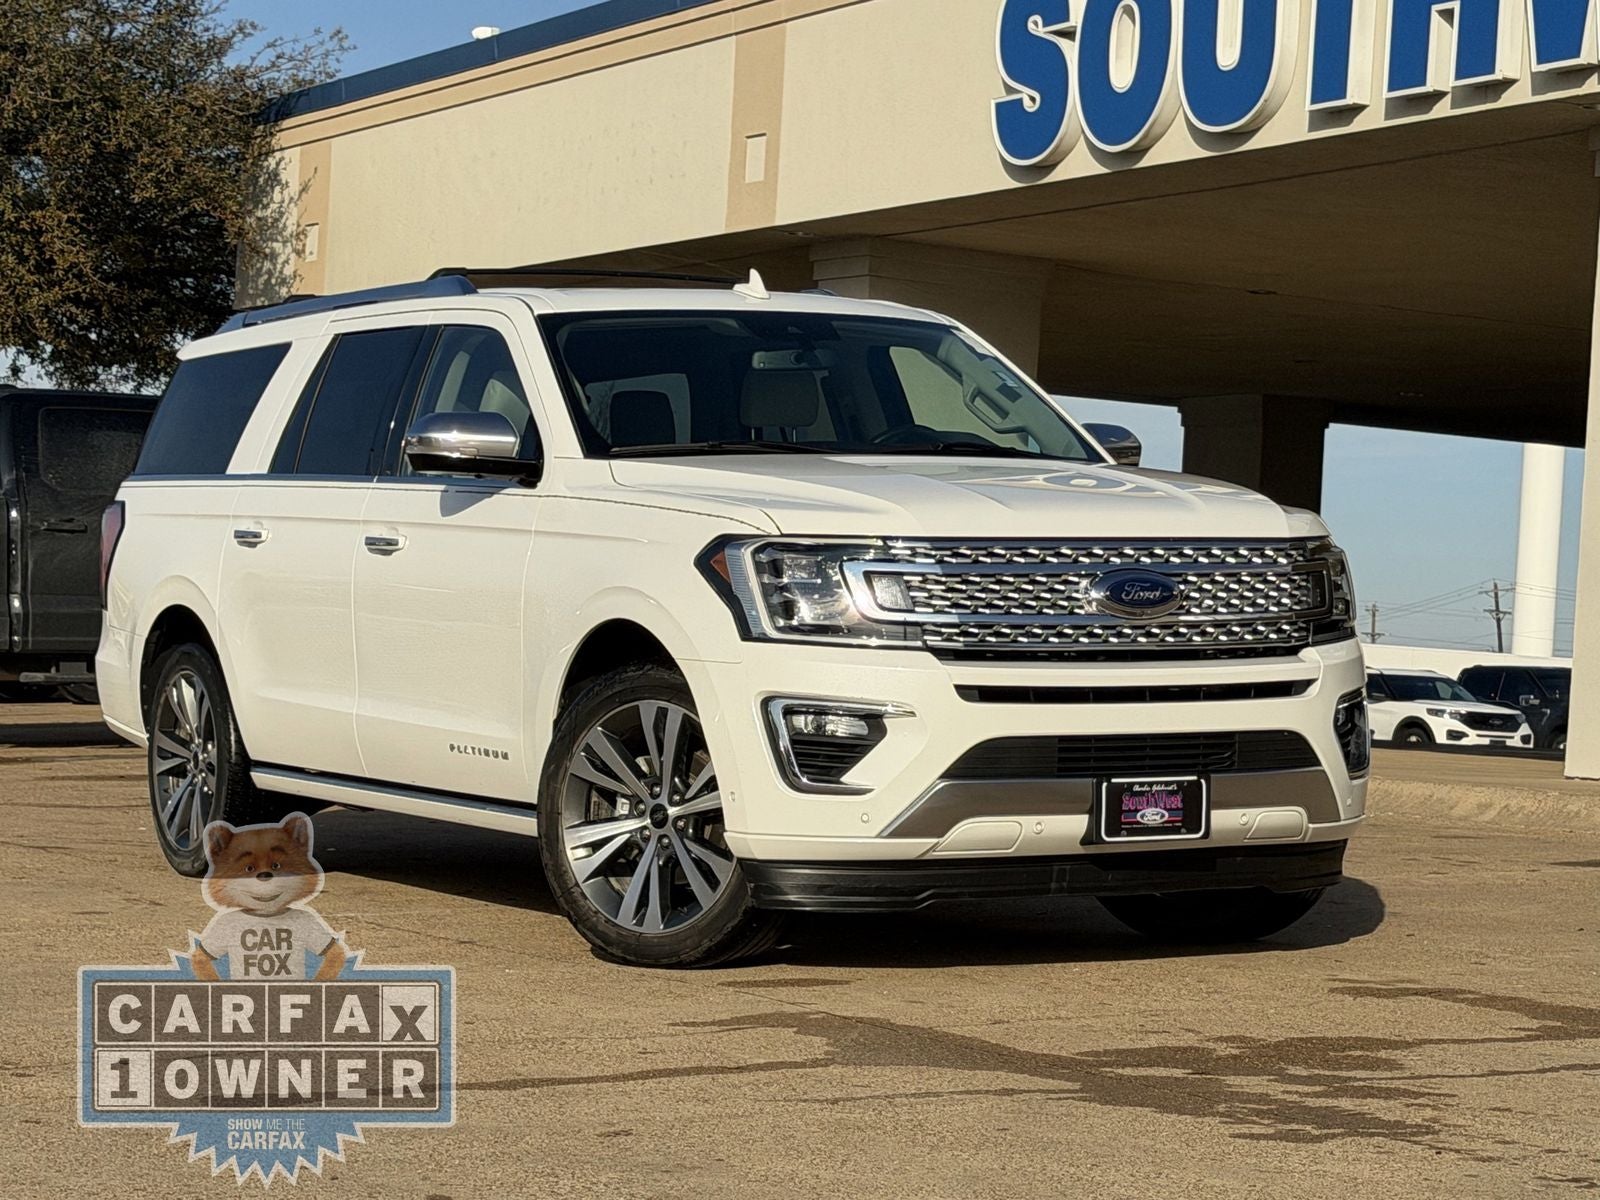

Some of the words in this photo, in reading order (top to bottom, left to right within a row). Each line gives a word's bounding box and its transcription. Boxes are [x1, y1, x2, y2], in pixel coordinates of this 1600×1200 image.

[1121, 581, 1161, 600] Ford
[448, 743, 510, 760] PLATINUM
[1142, 811, 1162, 822] Ford
